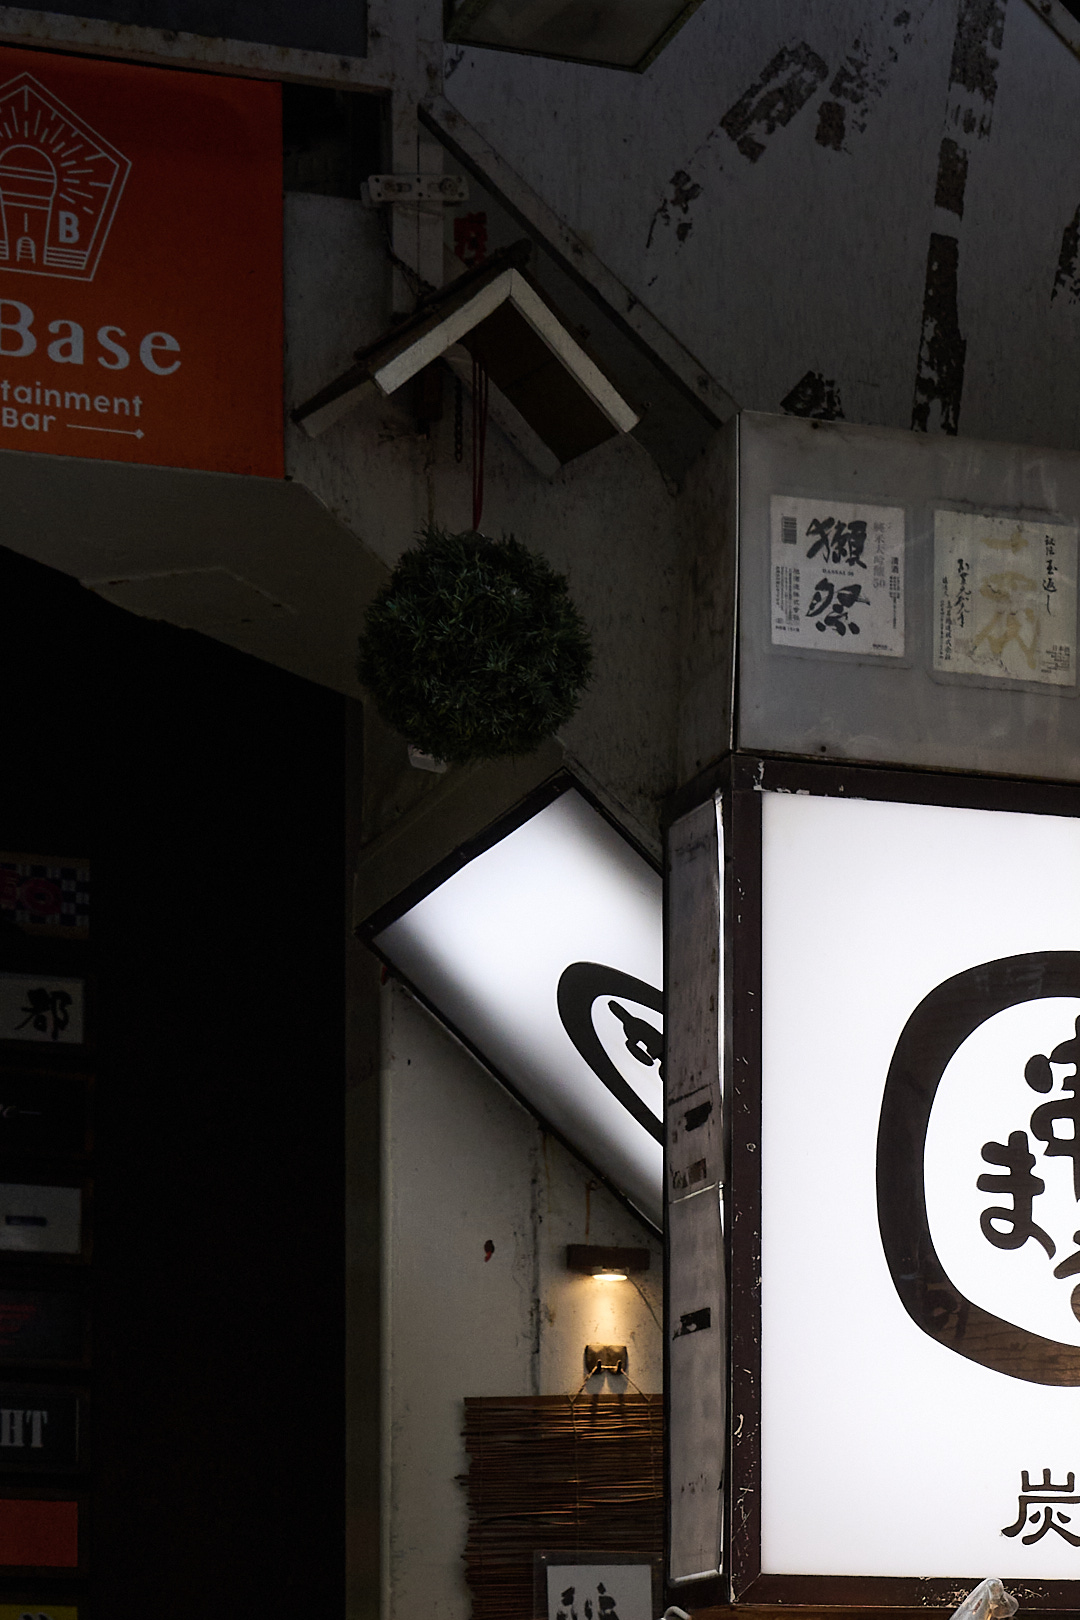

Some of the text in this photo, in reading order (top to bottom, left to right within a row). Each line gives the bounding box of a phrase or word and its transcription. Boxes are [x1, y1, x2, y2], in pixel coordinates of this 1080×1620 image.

[0, 298, 182, 377] Base
[0, 378, 144, 419] tainment
[1, 407, 57, 433] Bar
